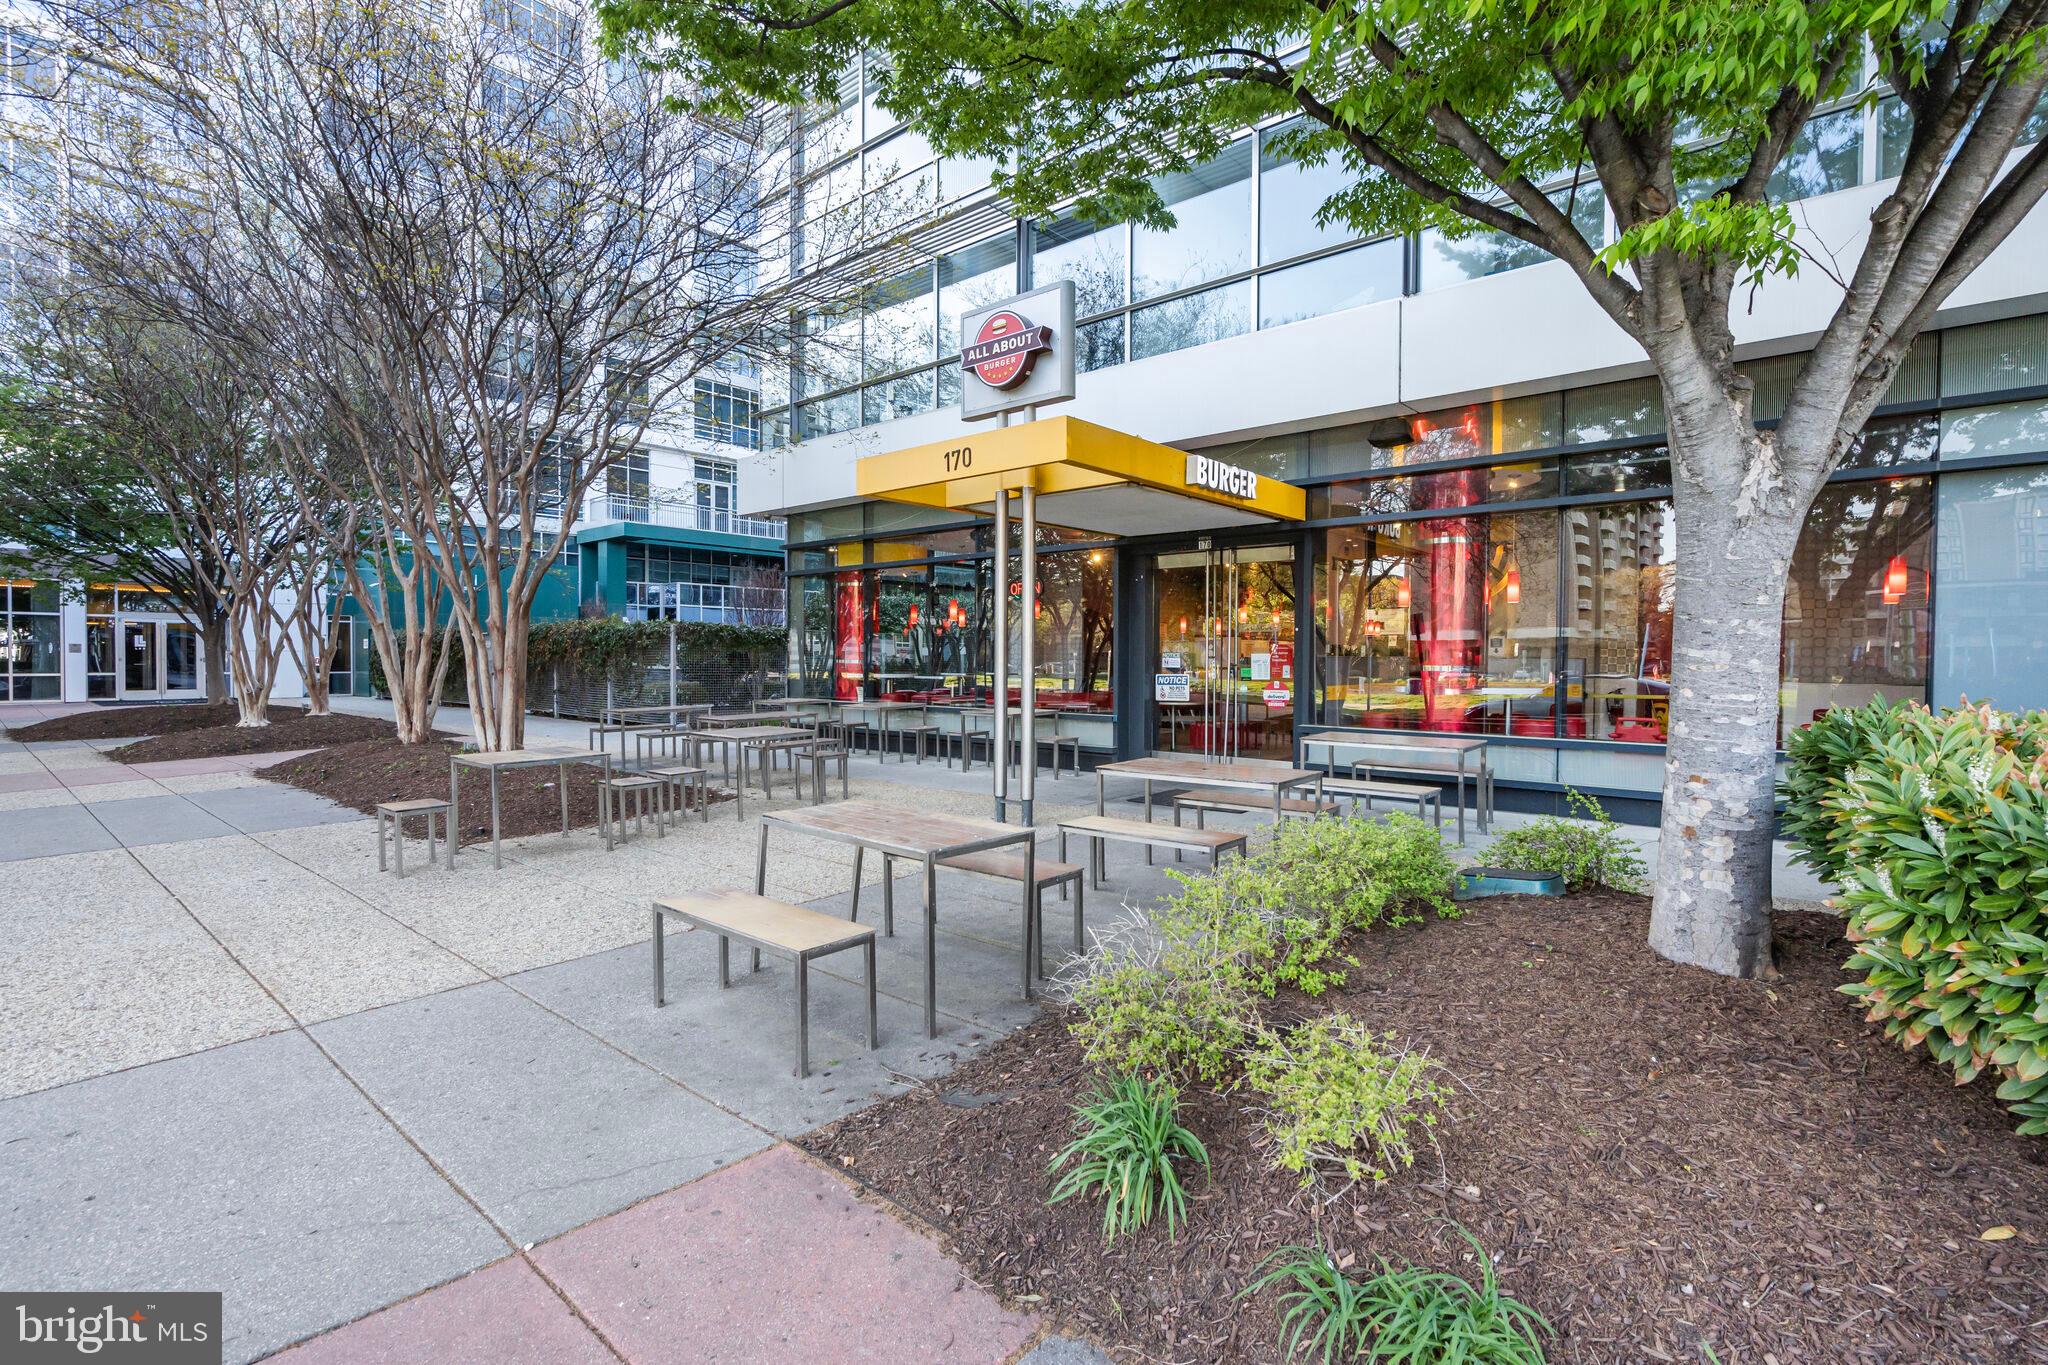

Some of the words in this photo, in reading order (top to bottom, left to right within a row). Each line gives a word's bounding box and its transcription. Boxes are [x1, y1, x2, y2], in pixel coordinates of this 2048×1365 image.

[968, 346, 990, 361] ALL
[992, 332, 1034, 355] ABOUT
[984, 356, 1016, 371] BURGER
[944, 447, 972, 472] 170
[1195, 455, 1257, 499] BURGER
[1158, 676, 1187, 684] NOTICE
